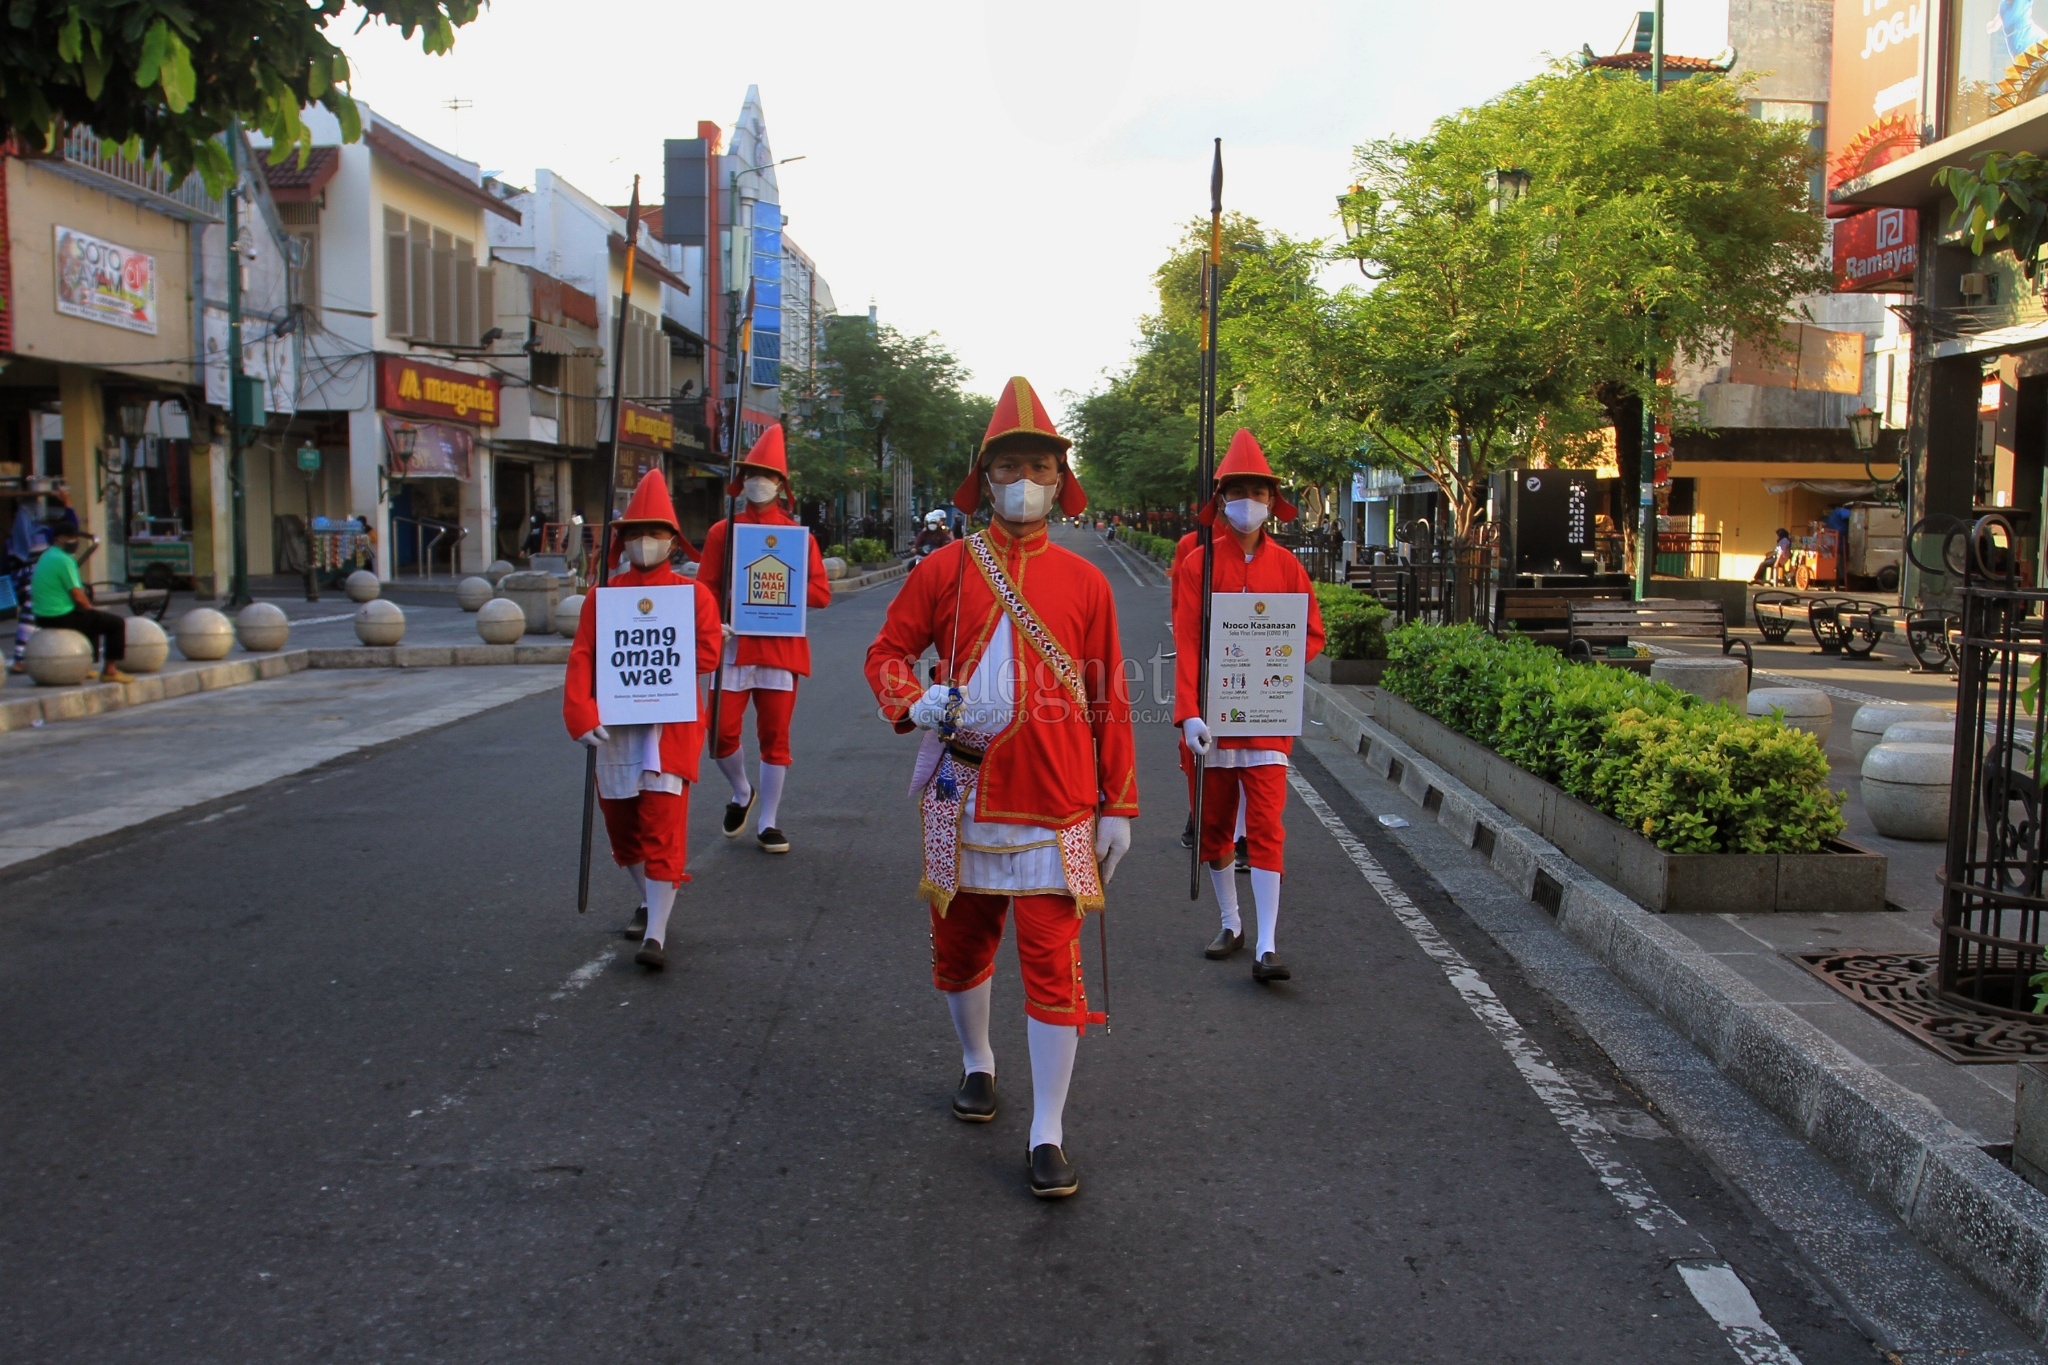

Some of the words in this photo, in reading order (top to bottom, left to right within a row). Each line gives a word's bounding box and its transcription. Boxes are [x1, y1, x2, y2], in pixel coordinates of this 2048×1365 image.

[76, 238, 121, 272] SOTO
[1846, 244, 1916, 279] Ramaya
[78, 262, 123, 297] AYAM
[423, 377, 494, 416] margaria
[753, 571, 783, 581] NANG
[753, 581, 785, 591] OMAH
[753, 590, 776, 600] WAE
[614, 627, 676, 648] nang
[1225, 646, 1229, 656] 1
[1265, 646, 1271, 656] 2
[610, 647, 681, 668] omah
[619, 668, 672, 687] wae
[1222, 678, 1228, 687] 3
[1263, 678, 1269, 687] 4
[1221, 712, 1227, 722] 5
